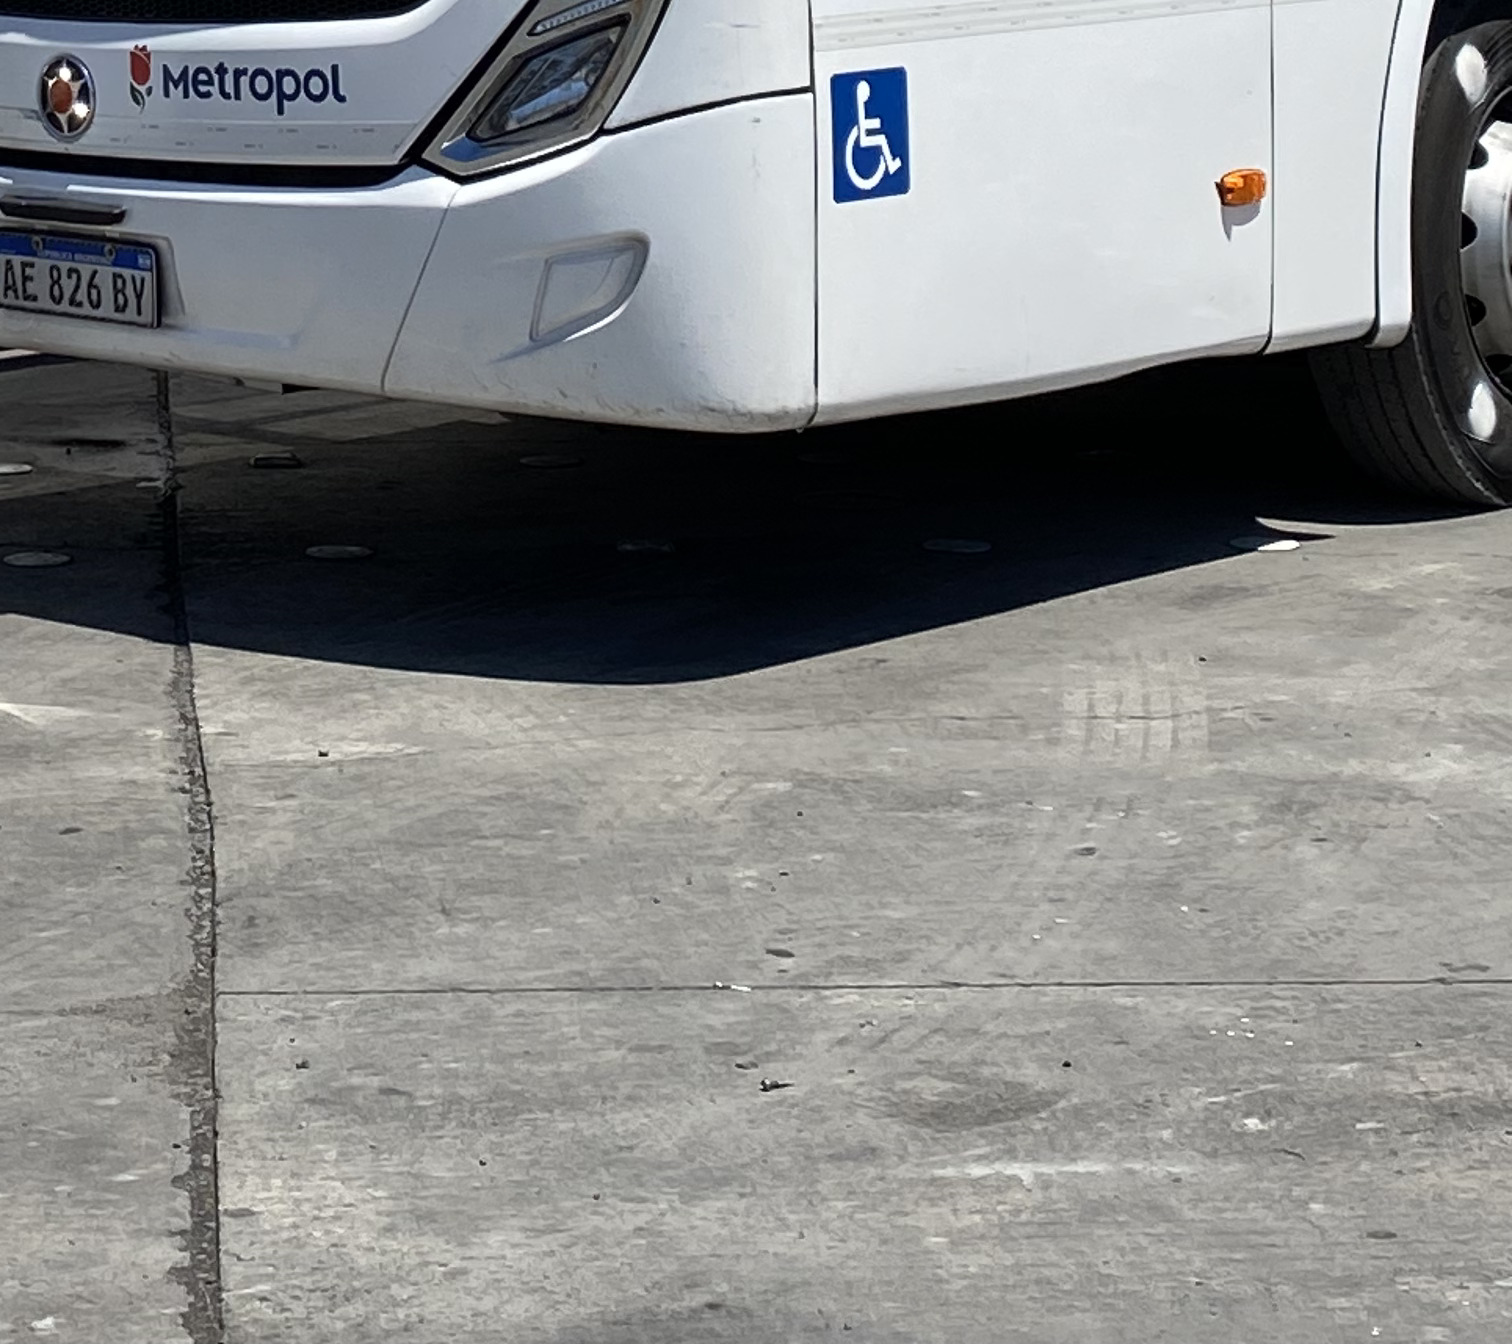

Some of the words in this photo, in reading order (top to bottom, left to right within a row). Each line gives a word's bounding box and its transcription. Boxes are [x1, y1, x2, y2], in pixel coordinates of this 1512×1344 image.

[162, 59, 348, 116] Metropol
[2, 258, 38, 301] AE
[49, 263, 103, 310] 826
[112, 272, 147, 316] BY
